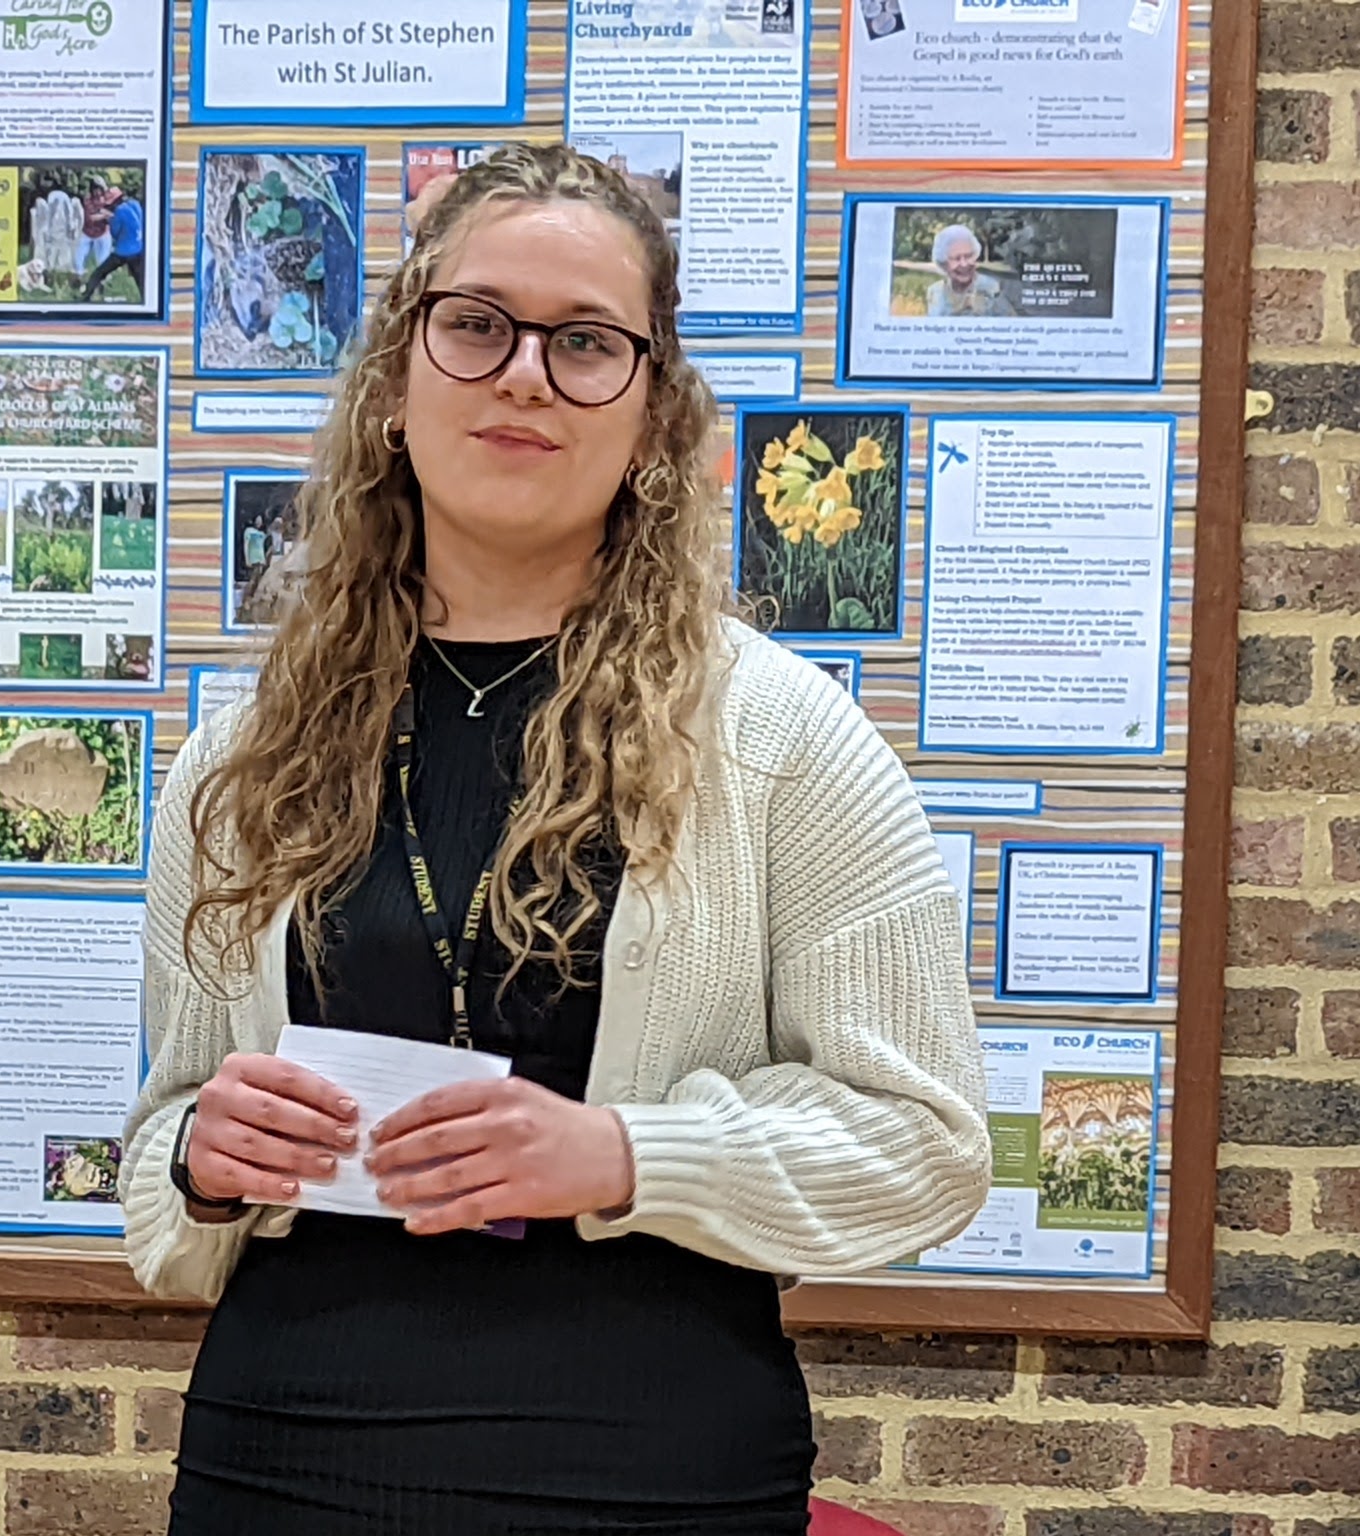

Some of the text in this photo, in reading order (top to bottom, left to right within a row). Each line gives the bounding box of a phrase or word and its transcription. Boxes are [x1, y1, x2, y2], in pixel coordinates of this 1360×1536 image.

[575, 2, 634, 17] Living
[218, 21, 495, 48] The Parish of St Stephen
[575, 23, 693, 40] Churchyards
[915, 31, 938, 44] Eco
[941, 31, 980, 44] church
[1078, 31, 1100, 44] that
[1104, 31, 1122, 44] the
[913, 48, 954, 63] Gospel
[957, 48, 966, 60] is
[969, 48, 999, 63] good
[1002, 51, 1031, 60] news
[1035, 48, 1052, 60] for
[1093, 48, 1123, 60] earth
[278, 61, 433, 84] with St Julian.
[409, 856, 437, 915] STUDENT
[1053, 1036, 1150, 1049] ECO CHURCH
